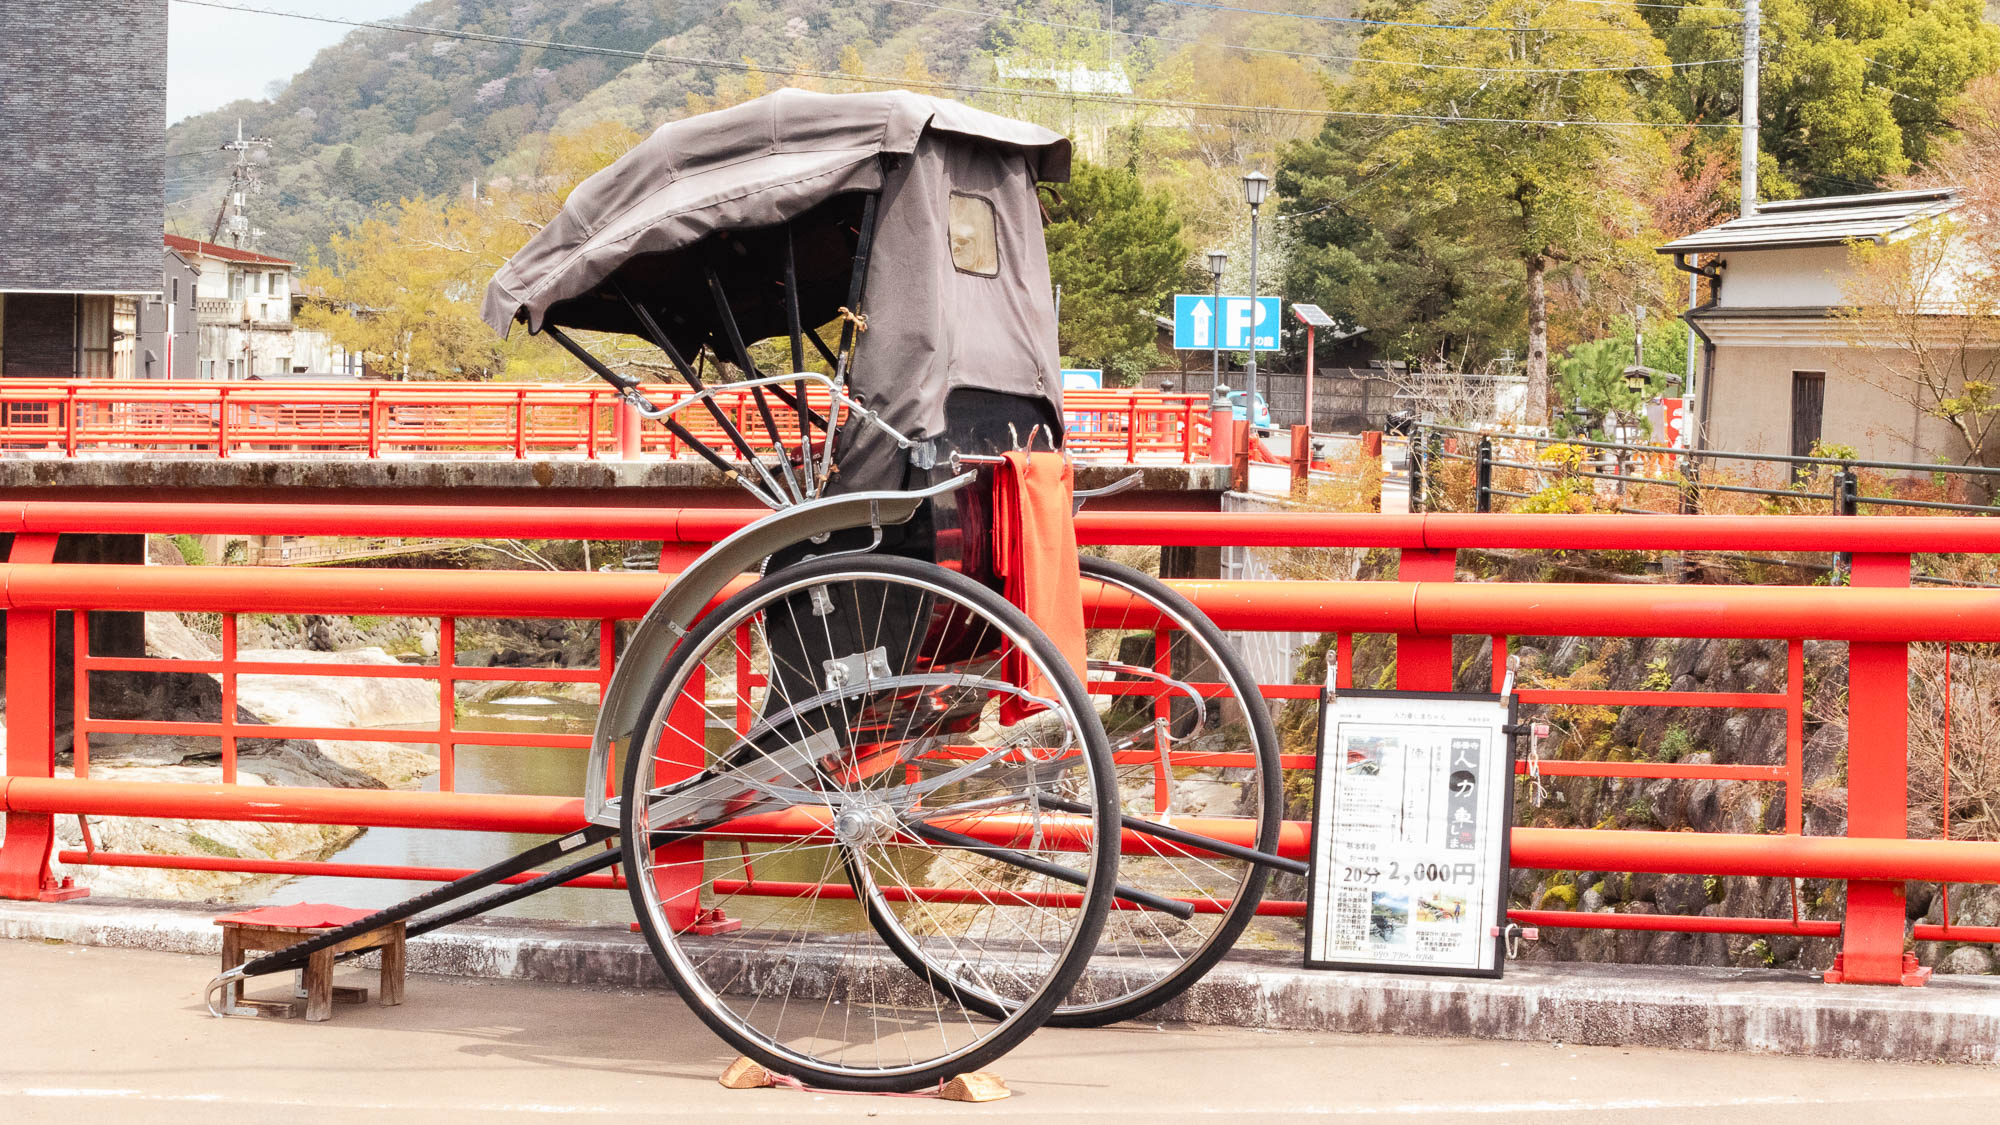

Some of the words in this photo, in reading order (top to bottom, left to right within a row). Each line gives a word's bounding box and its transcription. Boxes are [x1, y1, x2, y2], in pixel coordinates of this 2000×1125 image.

[1227, 299, 1266, 346] P
[1343, 867, 1381, 884] 20分
[1388, 861, 1476, 886] 2,000円
